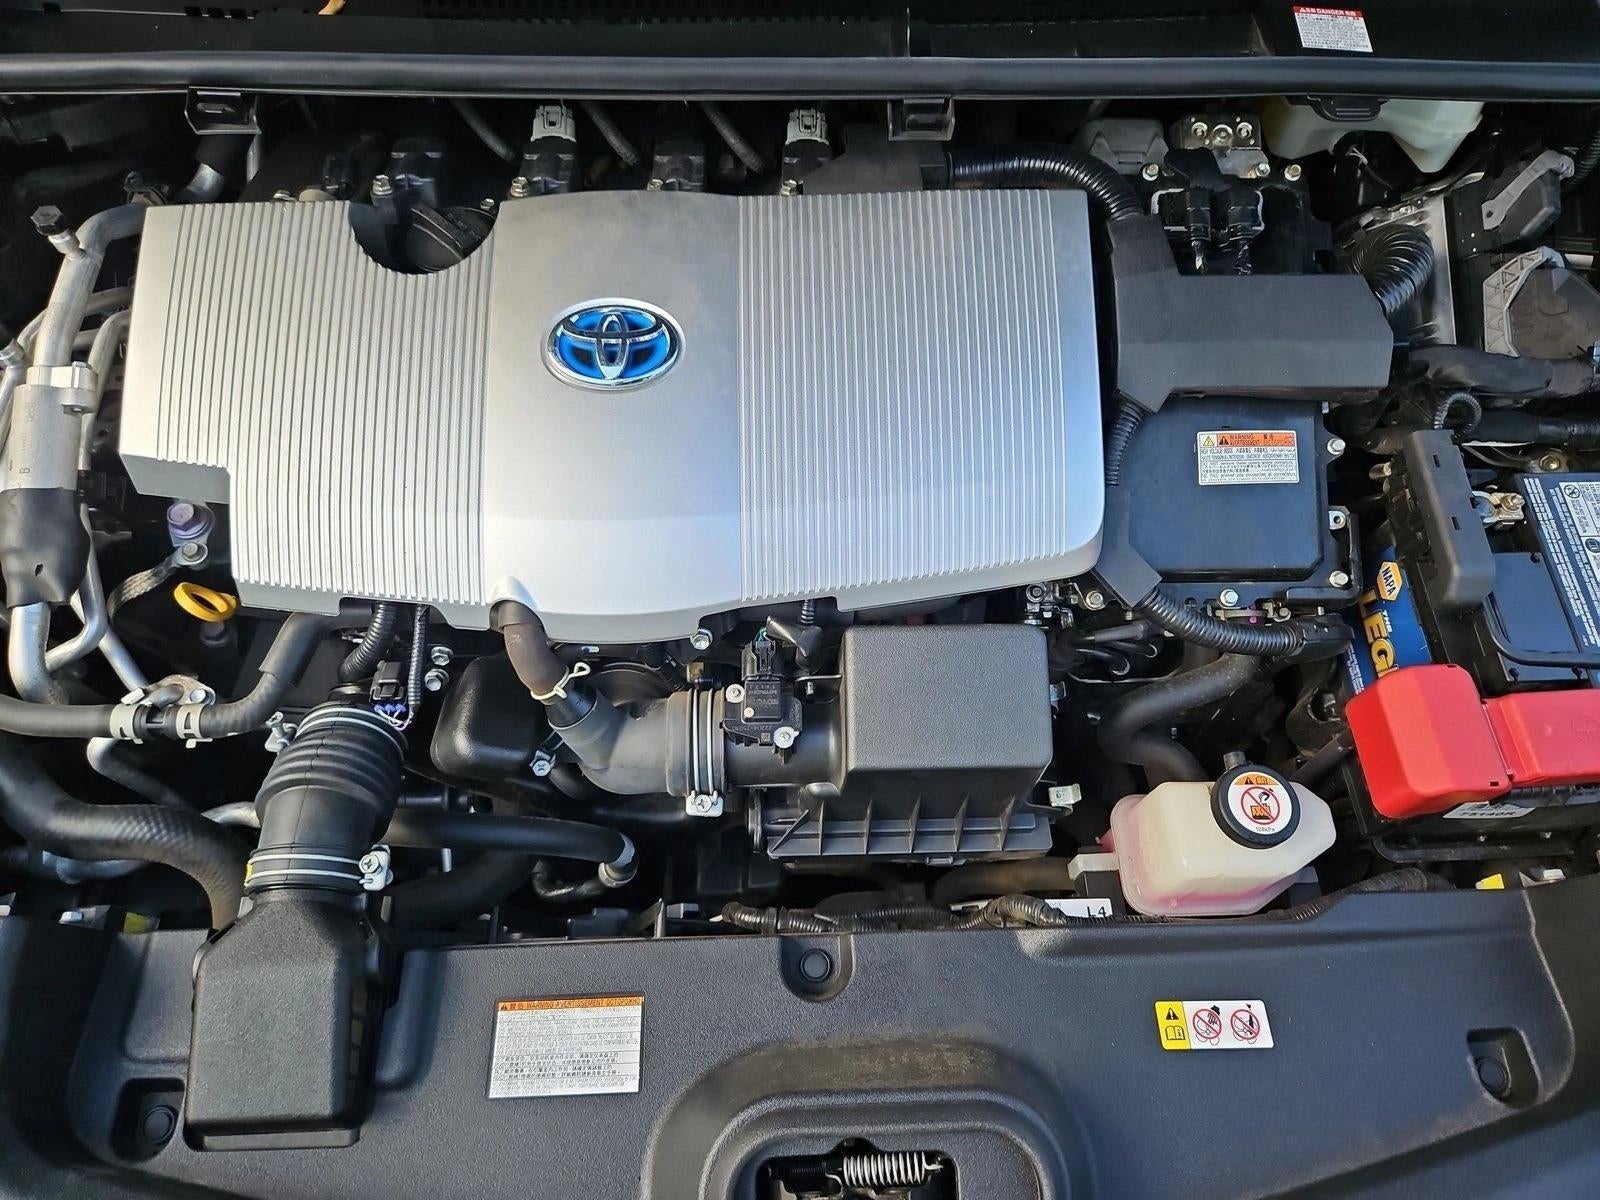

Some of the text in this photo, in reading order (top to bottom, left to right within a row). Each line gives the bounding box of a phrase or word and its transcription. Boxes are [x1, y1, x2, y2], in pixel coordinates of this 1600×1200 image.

[1382, 566, 1397, 596] NAPA
[1358, 589, 1398, 678] LEG
[1382, 610, 1392, 632] THE
